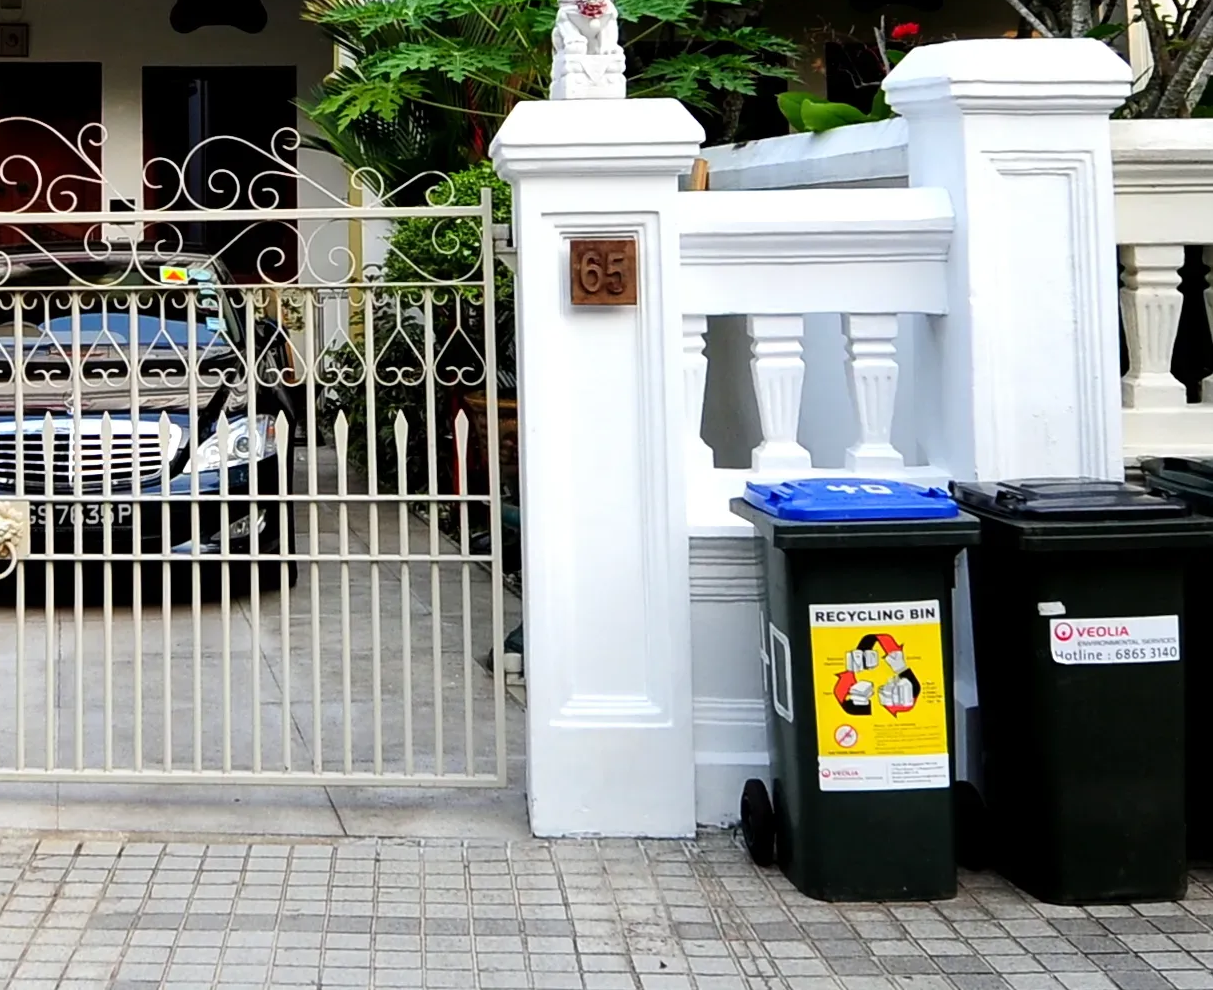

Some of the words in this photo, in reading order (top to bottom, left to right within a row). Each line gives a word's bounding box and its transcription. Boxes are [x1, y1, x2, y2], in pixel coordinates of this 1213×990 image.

[580, 250, 624, 294] 65
[815, 609, 905, 622] RECYCLING
[910, 607, 936, 619] BIN
[1076, 625, 1130, 638] VEOLIA
[1077, 639, 1139, 647] ENVIRONMENTAL
[1141, 637, 1177, 645] SERVICES
[1055, 649, 1103, 661] Hotline
[1115, 648, 1147, 660] 6865
[1151, 646, 1178, 658] 3140
